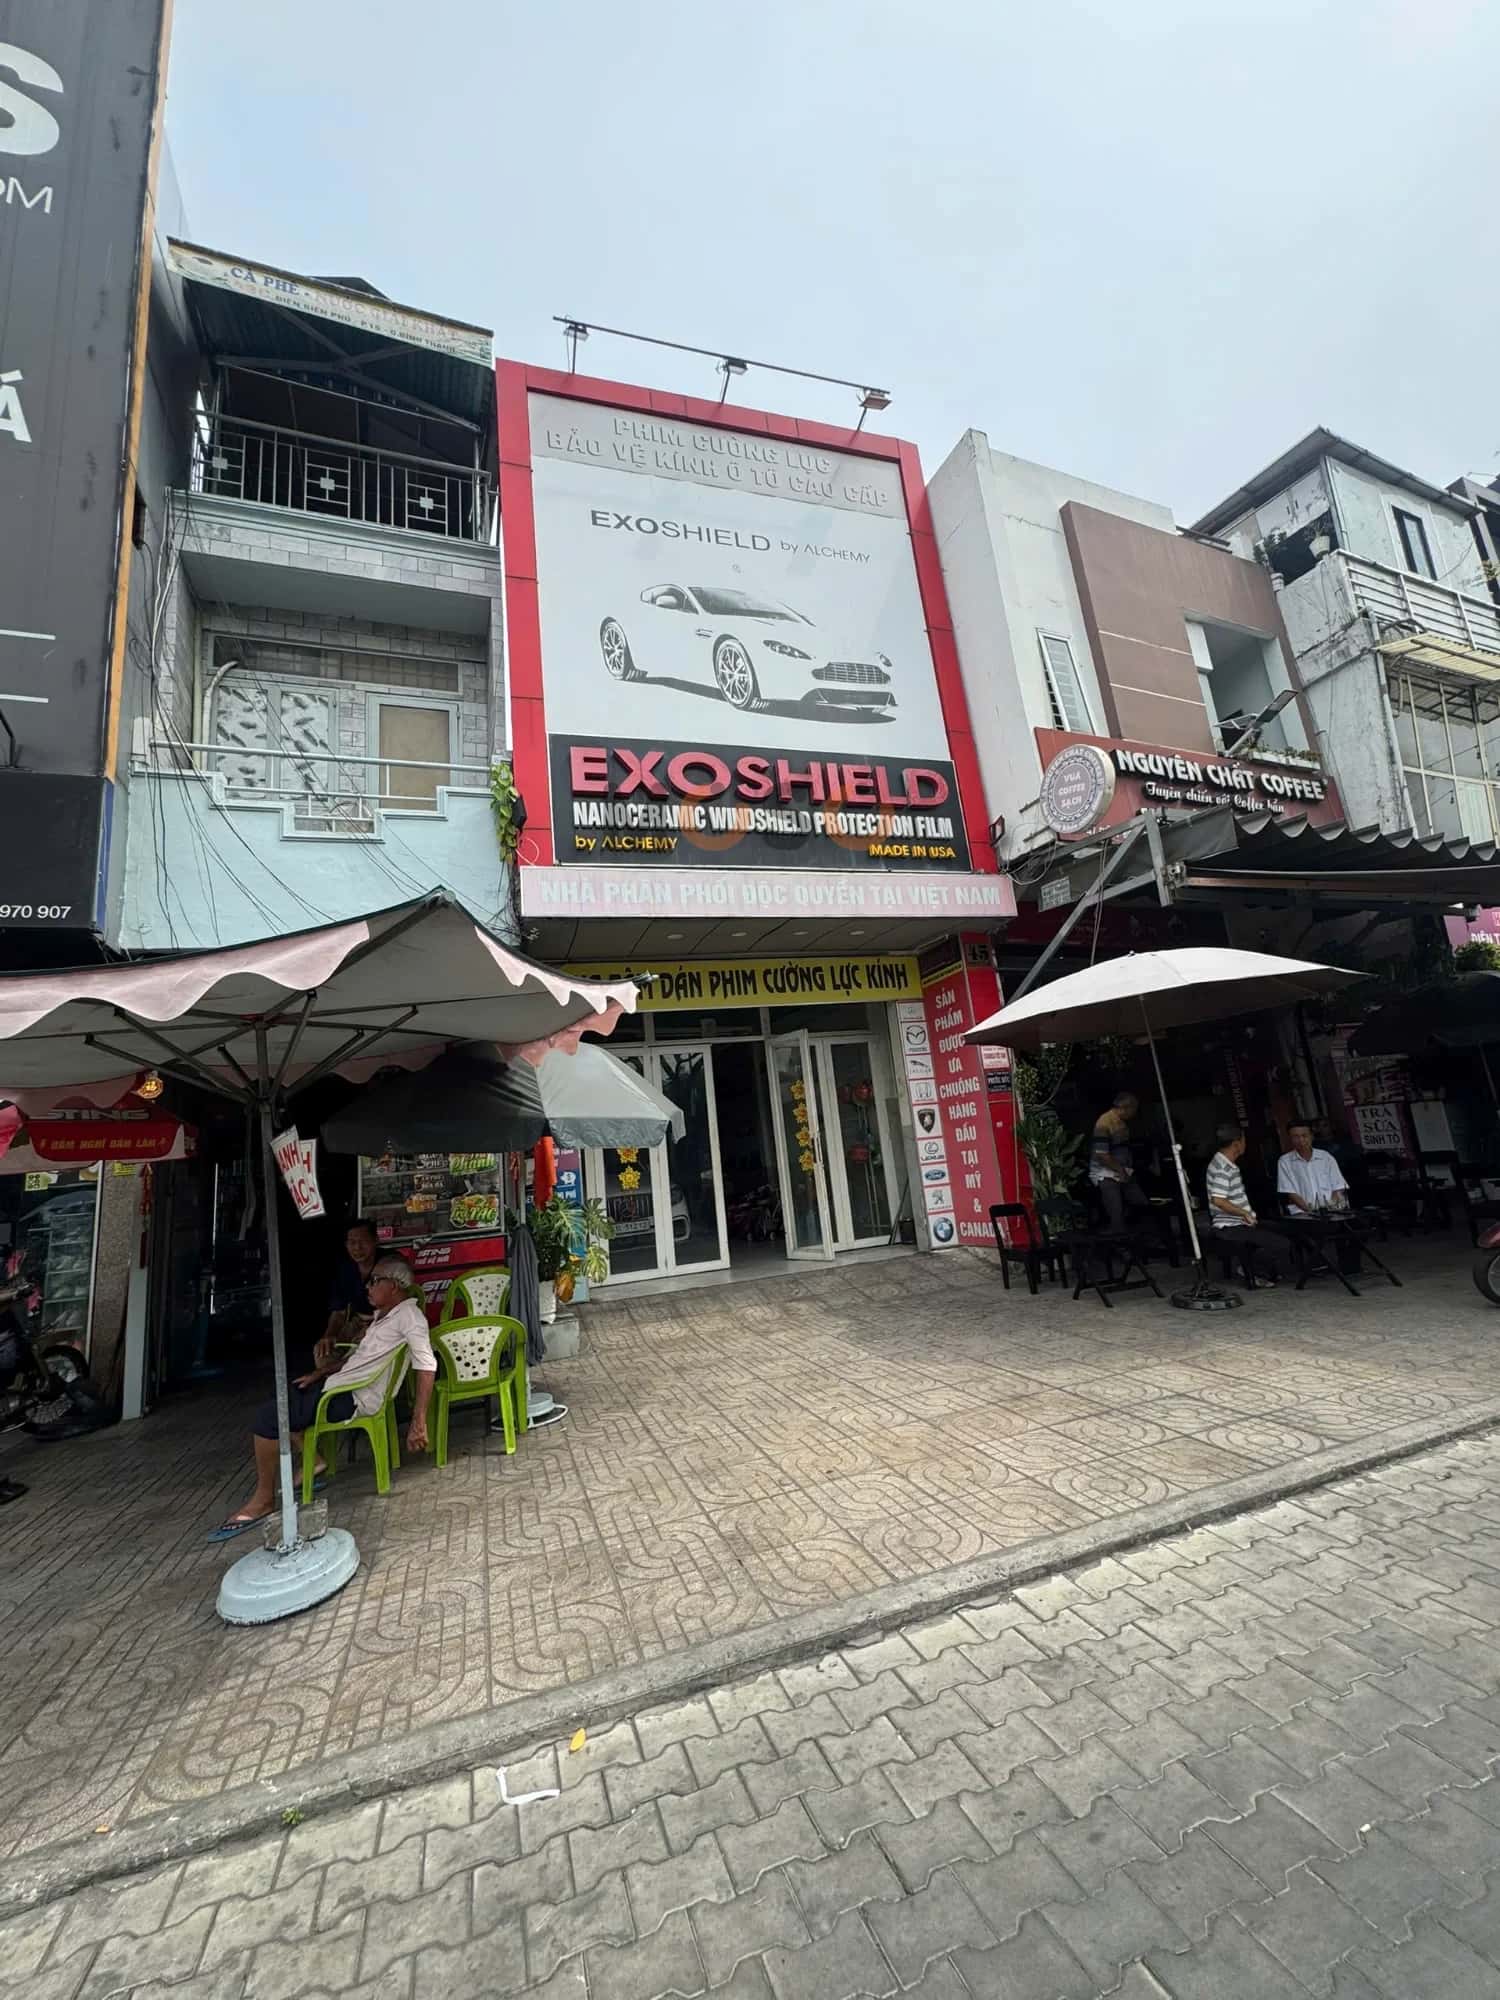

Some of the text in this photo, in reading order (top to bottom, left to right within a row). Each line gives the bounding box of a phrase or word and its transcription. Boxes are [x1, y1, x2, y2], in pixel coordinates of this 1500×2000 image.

[612, 416, 686, 450] PHIM
[612, 441, 647, 469] VỆ
[655, 448, 718, 479] KÍNH
[750, 466, 779, 489] TÔ
[789, 474, 834, 500] CAO
[591, 509, 872, 564] EXOSHIELD by ALCHEMY
[567, 746, 950, 808] EXOSHIELD
[1115, 748, 1326, 800] NGUYÊN CHẤT COFFEE
[573, 802, 954, 840] NANOCERAMIC WINDSHIELD PROTECTION FILM
[575, 835, 679, 852] by ALCHEMY
[868, 843, 957, 860] MADE IN USA
[540, 878, 597, 905] NHÀ
[603, 878, 673, 906] PHÂN
[906, 883, 953, 911] VIỆT
[956, 886, 1001, 906] NAM
[37, 905, 72, 919] 907
[660, 965, 701, 1002] DÁN
[710, 969, 758, 1000] PHIM
[763, 963, 824, 996] CƯỜNG
[830, 962, 863, 996] LỰC
[866, 958, 908, 991] KÍNH
[949, 1102, 977, 1119] HÀNG
[1364, 1135, 1386, 1145] SINH
[961, 1148, 979, 1168] TẠI
[973, 1197, 983, 1213] &
